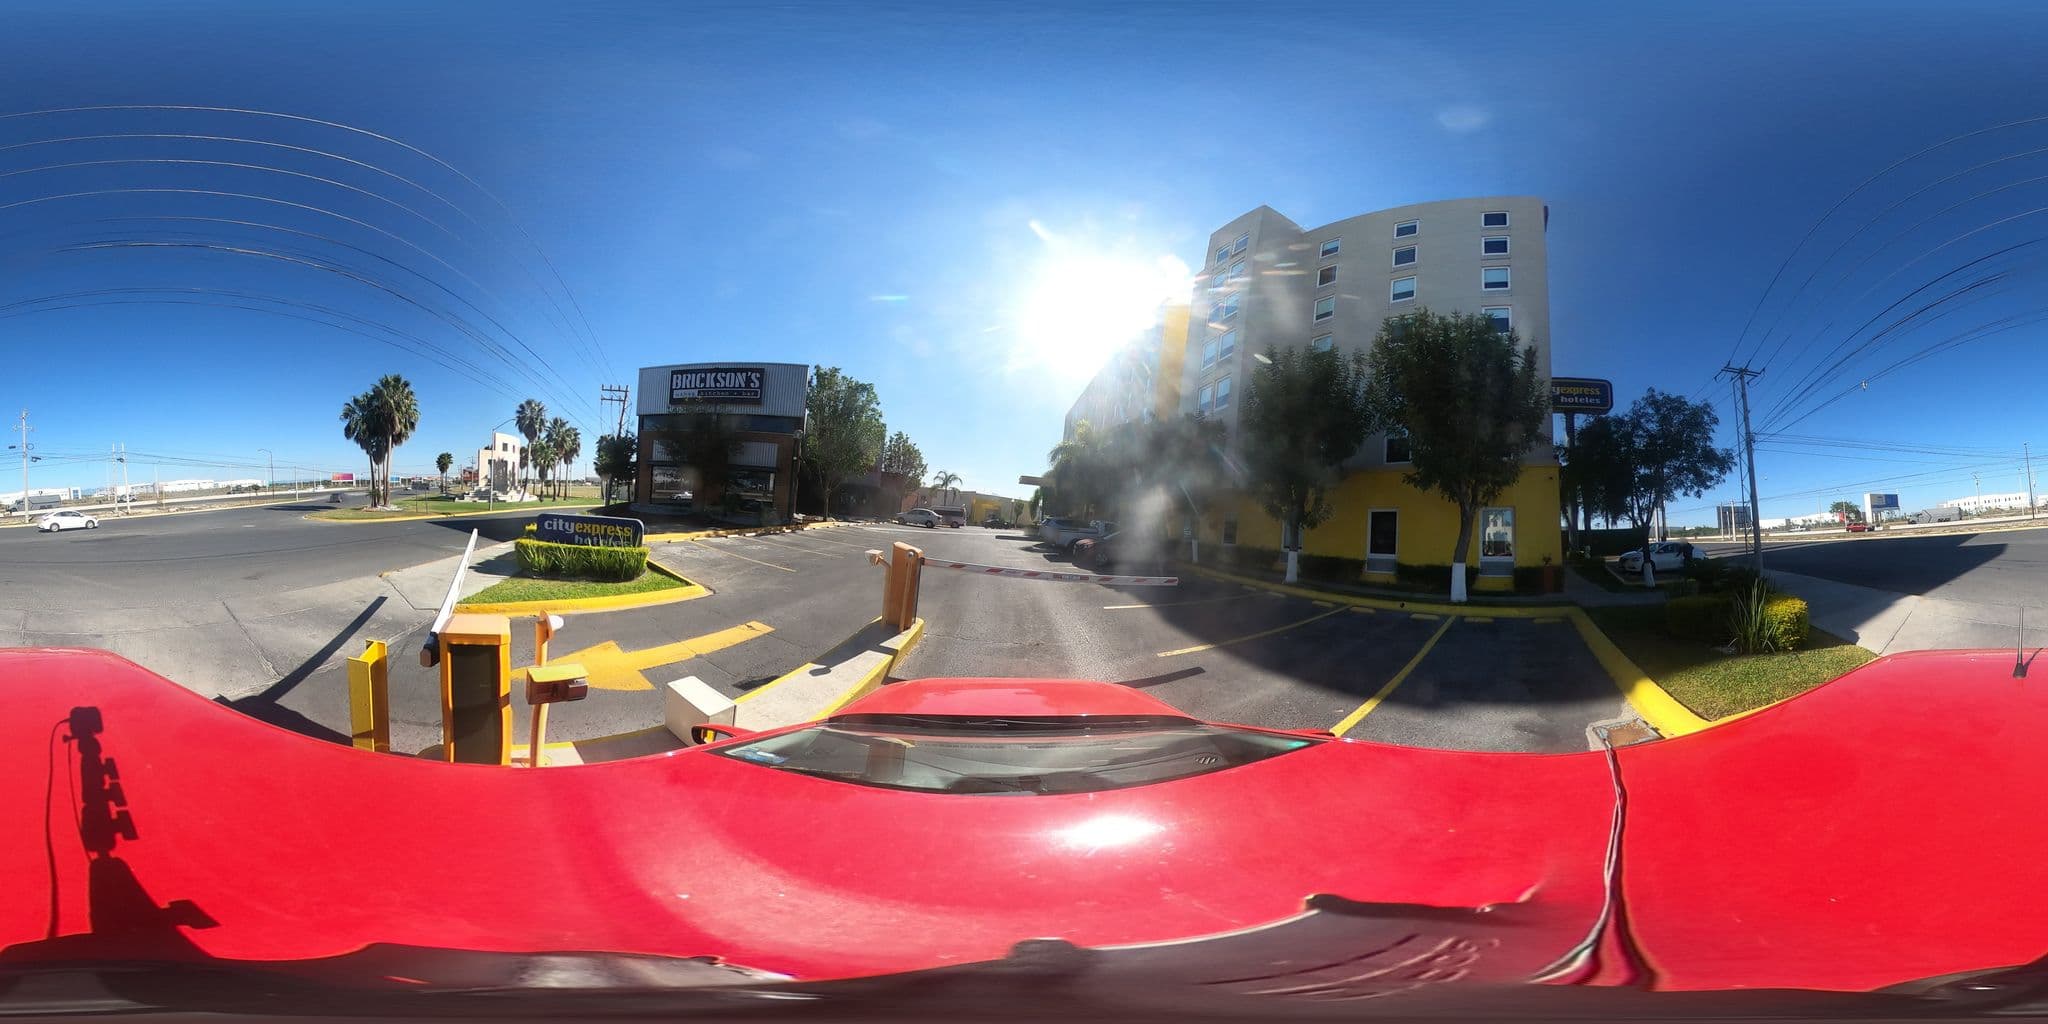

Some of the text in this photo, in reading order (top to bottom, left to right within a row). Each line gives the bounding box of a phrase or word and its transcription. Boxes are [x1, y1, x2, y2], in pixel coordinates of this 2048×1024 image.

[672, 372, 761, 389] BRICKSON'S
[1552, 387, 1601, 395] yexpress
[1560, 396, 1601, 404] hoteles
